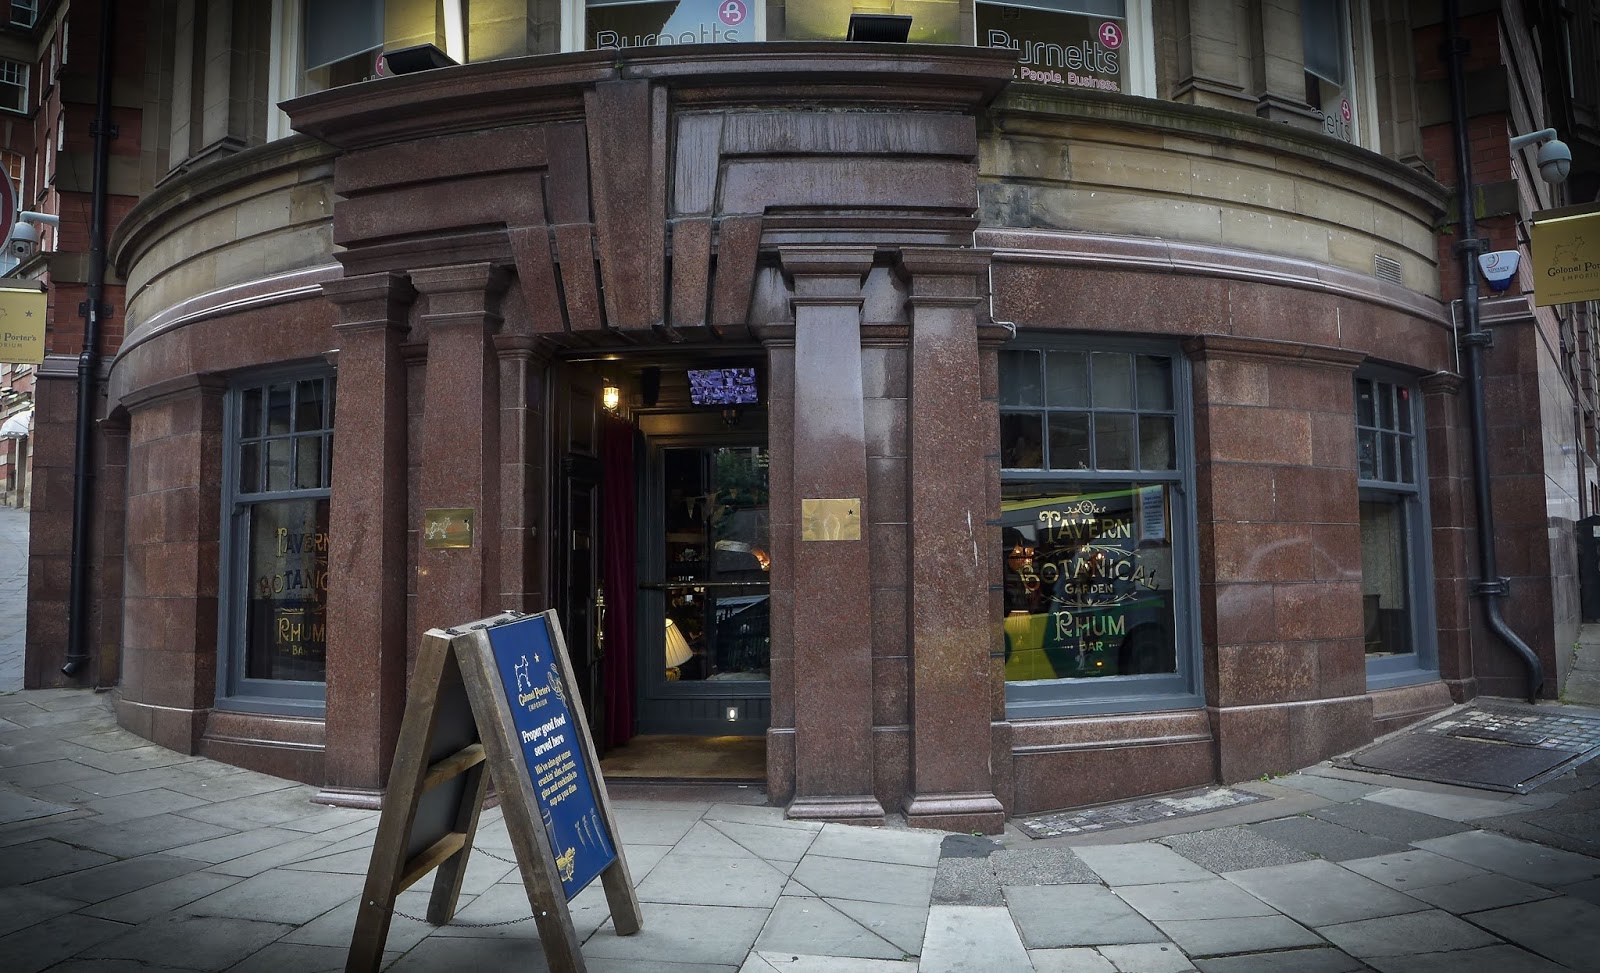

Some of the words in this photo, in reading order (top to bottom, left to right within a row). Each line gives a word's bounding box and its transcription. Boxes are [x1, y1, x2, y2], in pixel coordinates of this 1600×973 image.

[1021, 66, 1065, 84] People.
[1068, 72, 1120, 92] Business.
[4, 332, 37, 341] Porter's
[1039, 510, 1131, 544] TAVERN
[1018, 557, 1160, 595] BOTANICAL
[1065, 583, 1113, 595] GARDEN
[276, 617, 325, 645] RHUM
[1053, 611, 1126, 642] RHUM
[1080, 641, 1103, 652] BAR
[521, 727, 542, 743] Proper
[541, 718, 556, 737] good
[553, 713, 566, 728] food
[534, 737, 553, 756] served
[550, 735, 565, 747] here
